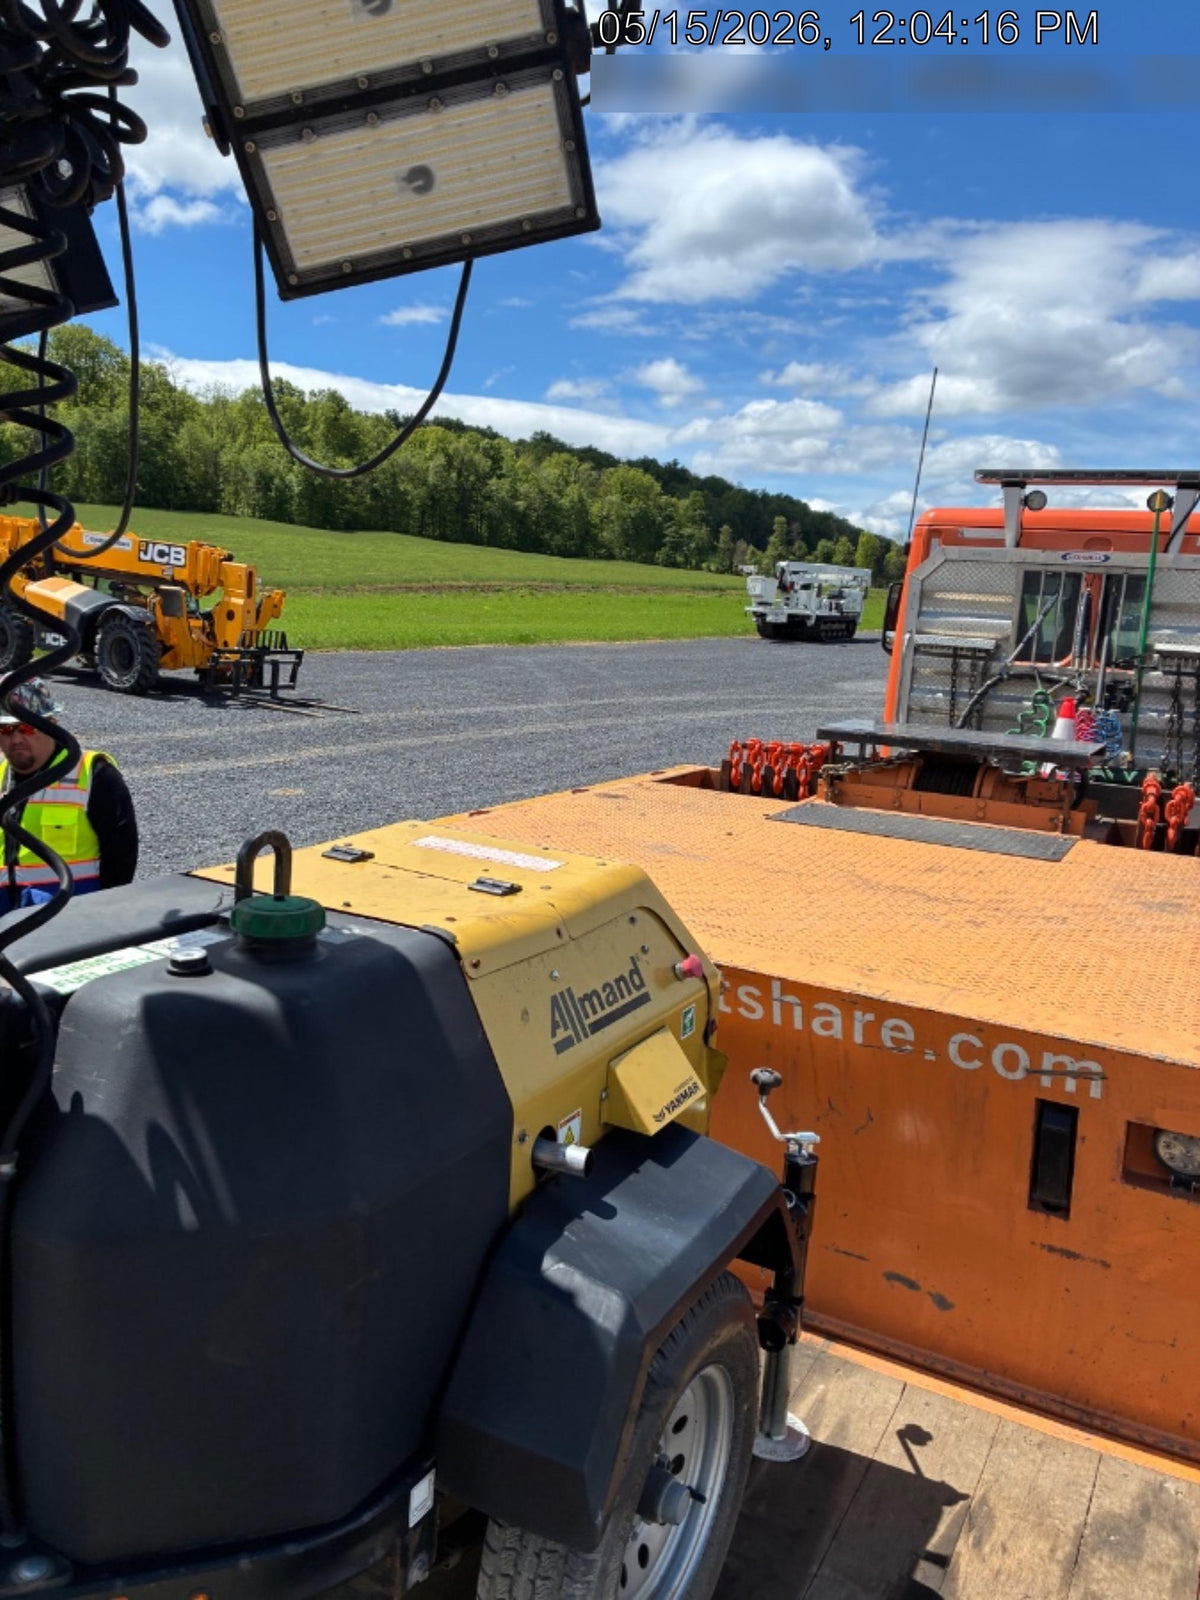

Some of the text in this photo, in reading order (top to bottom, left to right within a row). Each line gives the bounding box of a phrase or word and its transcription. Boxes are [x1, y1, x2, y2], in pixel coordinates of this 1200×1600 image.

[139, 542, 186, 566] JCB
[550, 955, 646, 1044] Allmand
[662, 1081, 699, 1115] YANMAR
